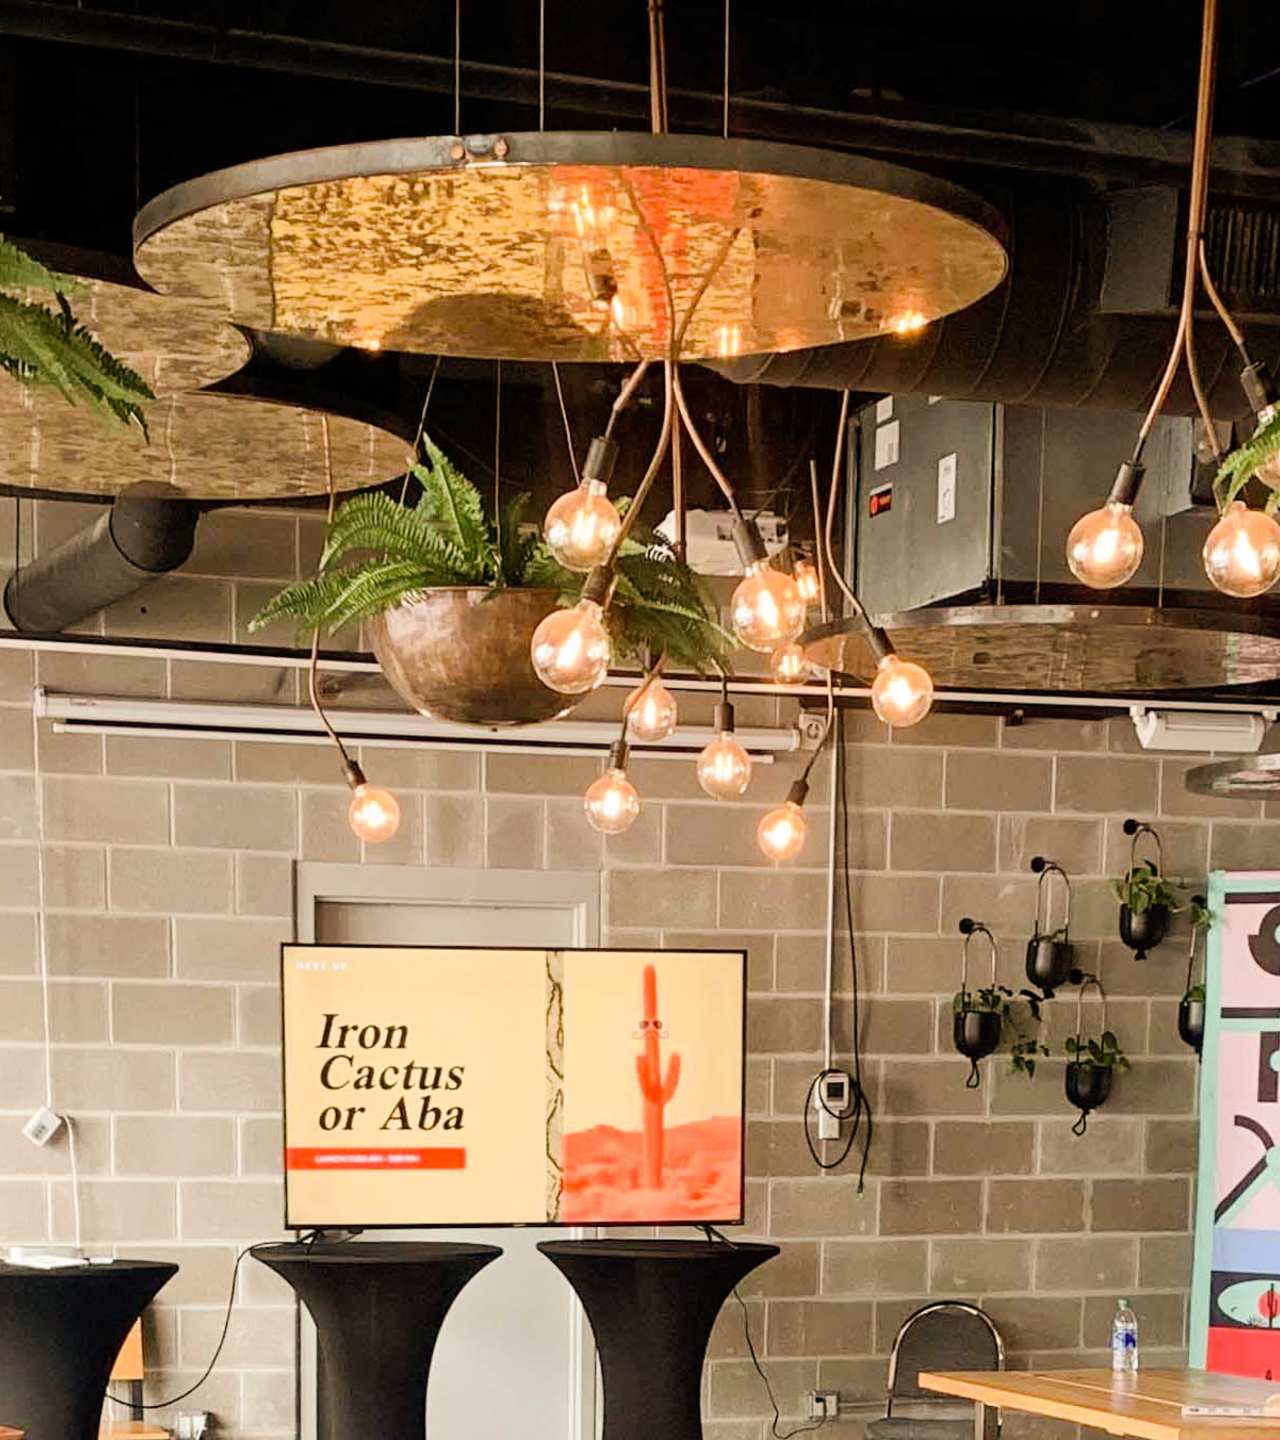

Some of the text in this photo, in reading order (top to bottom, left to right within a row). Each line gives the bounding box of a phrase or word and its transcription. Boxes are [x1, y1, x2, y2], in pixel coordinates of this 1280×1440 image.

[315, 1013, 409, 1049] Iron
[320, 1054, 466, 1091] Cactus
[319, 1095, 465, 1131] or Aba
